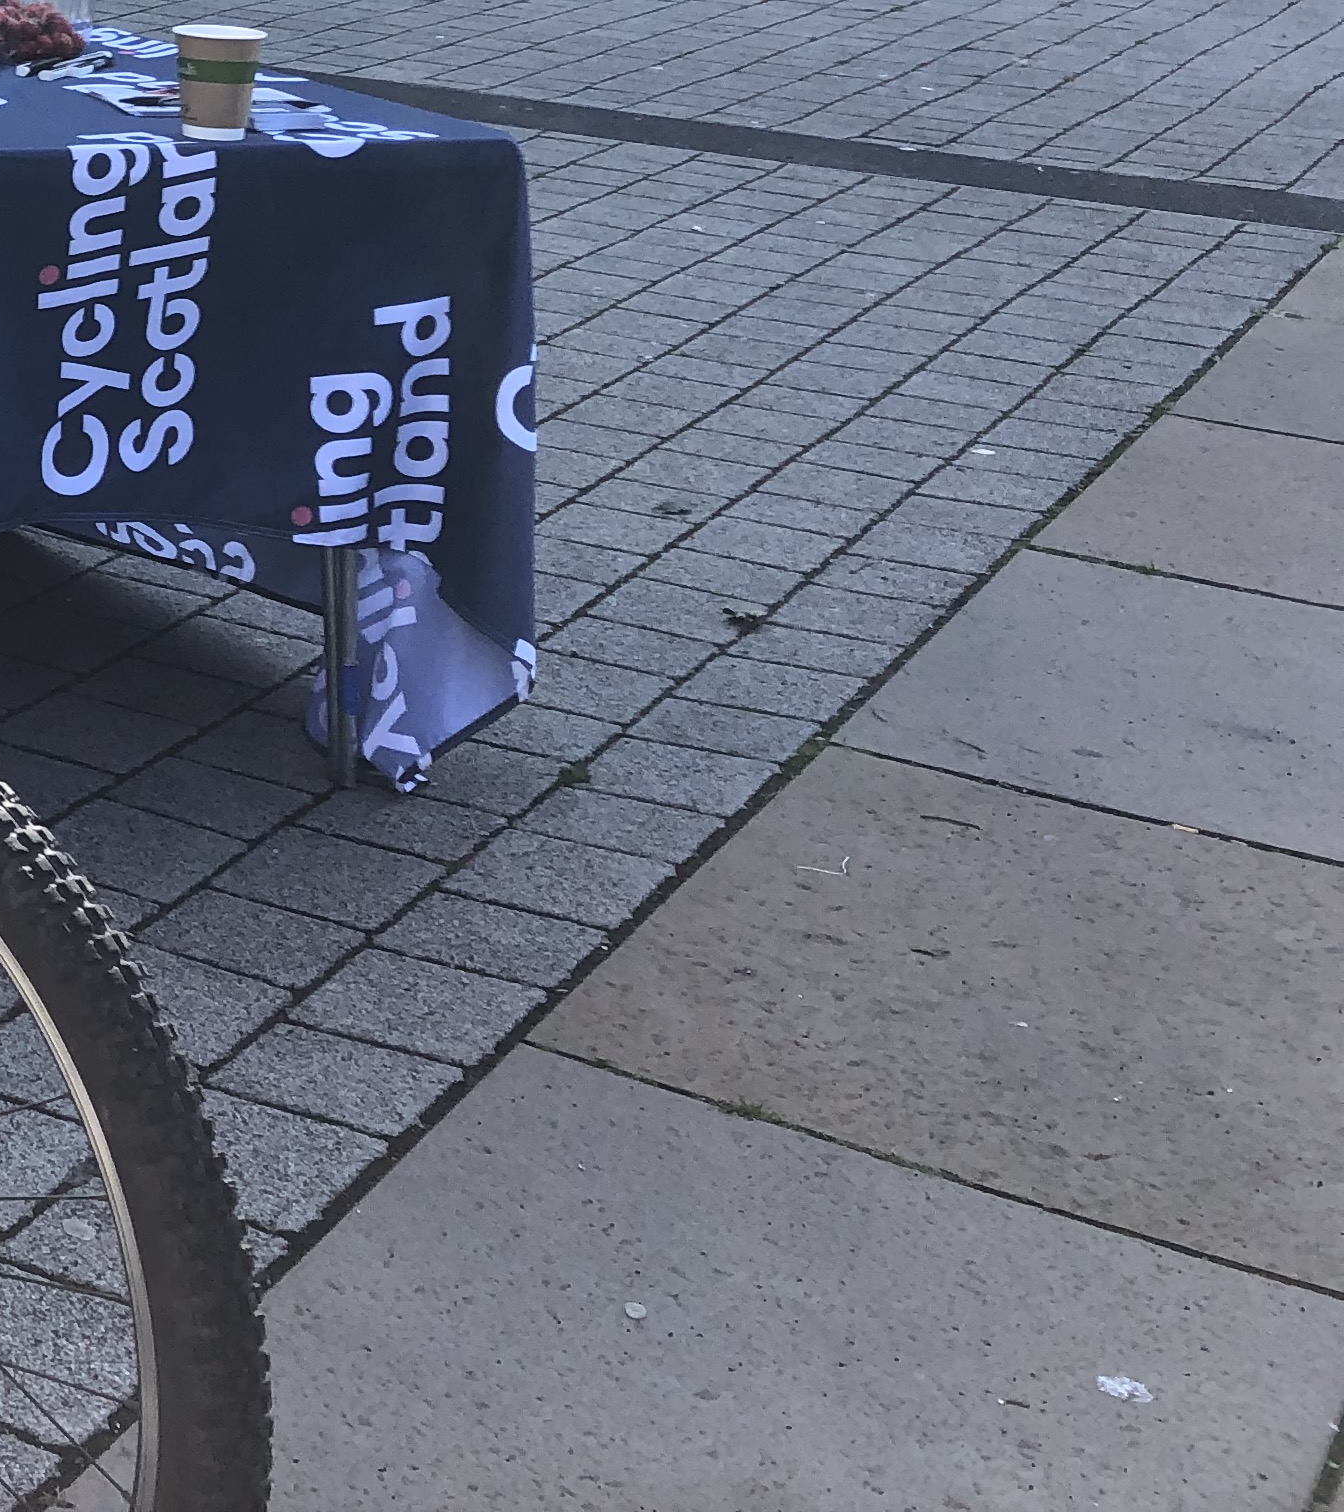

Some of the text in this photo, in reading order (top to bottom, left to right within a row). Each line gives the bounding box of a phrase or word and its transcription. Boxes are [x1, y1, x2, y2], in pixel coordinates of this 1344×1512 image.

[38, 145, 151, 497] Cycling
[374, 295, 452, 551] tland
[291, 371, 393, 548] ling
